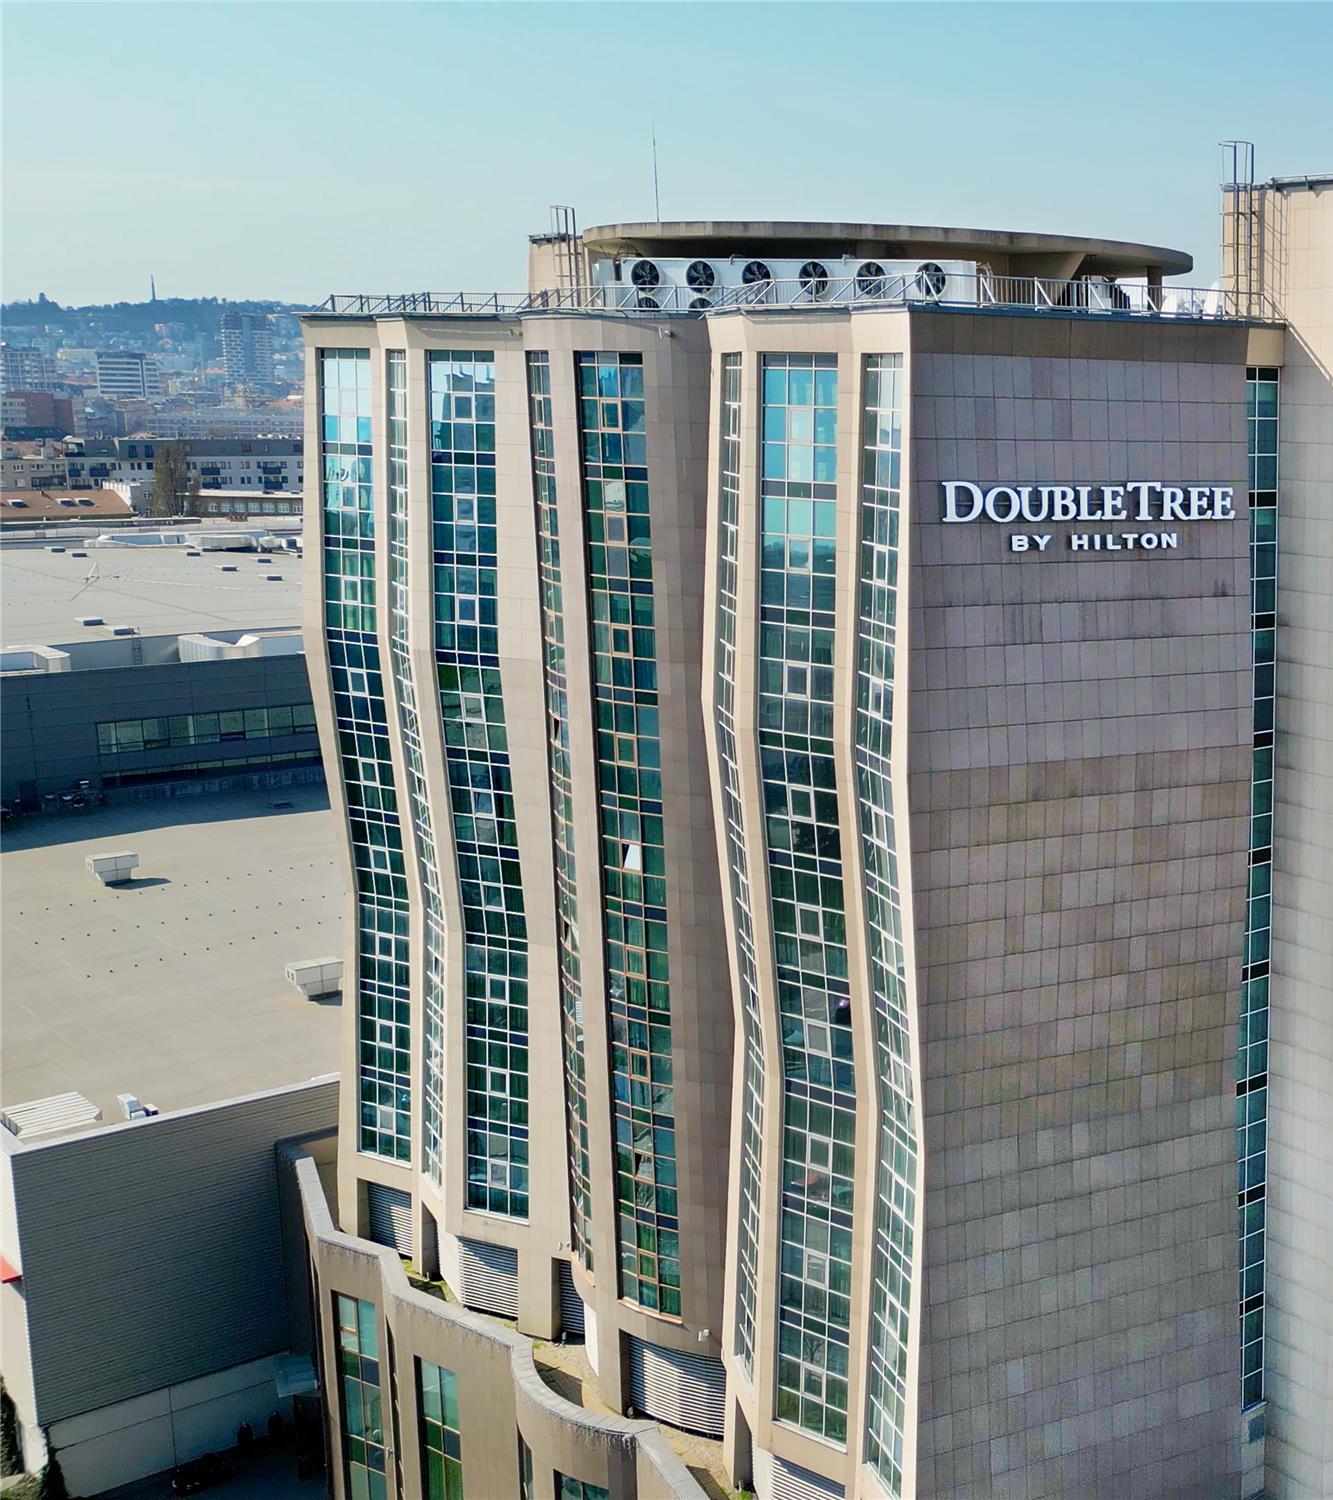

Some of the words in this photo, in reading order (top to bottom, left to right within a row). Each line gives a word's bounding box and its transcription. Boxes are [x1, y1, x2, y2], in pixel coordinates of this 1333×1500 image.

[941, 480, 1236, 524] DOUBLETREE
[1011, 534, 1052, 552] BY
[1071, 532, 1178, 551] HILTON
